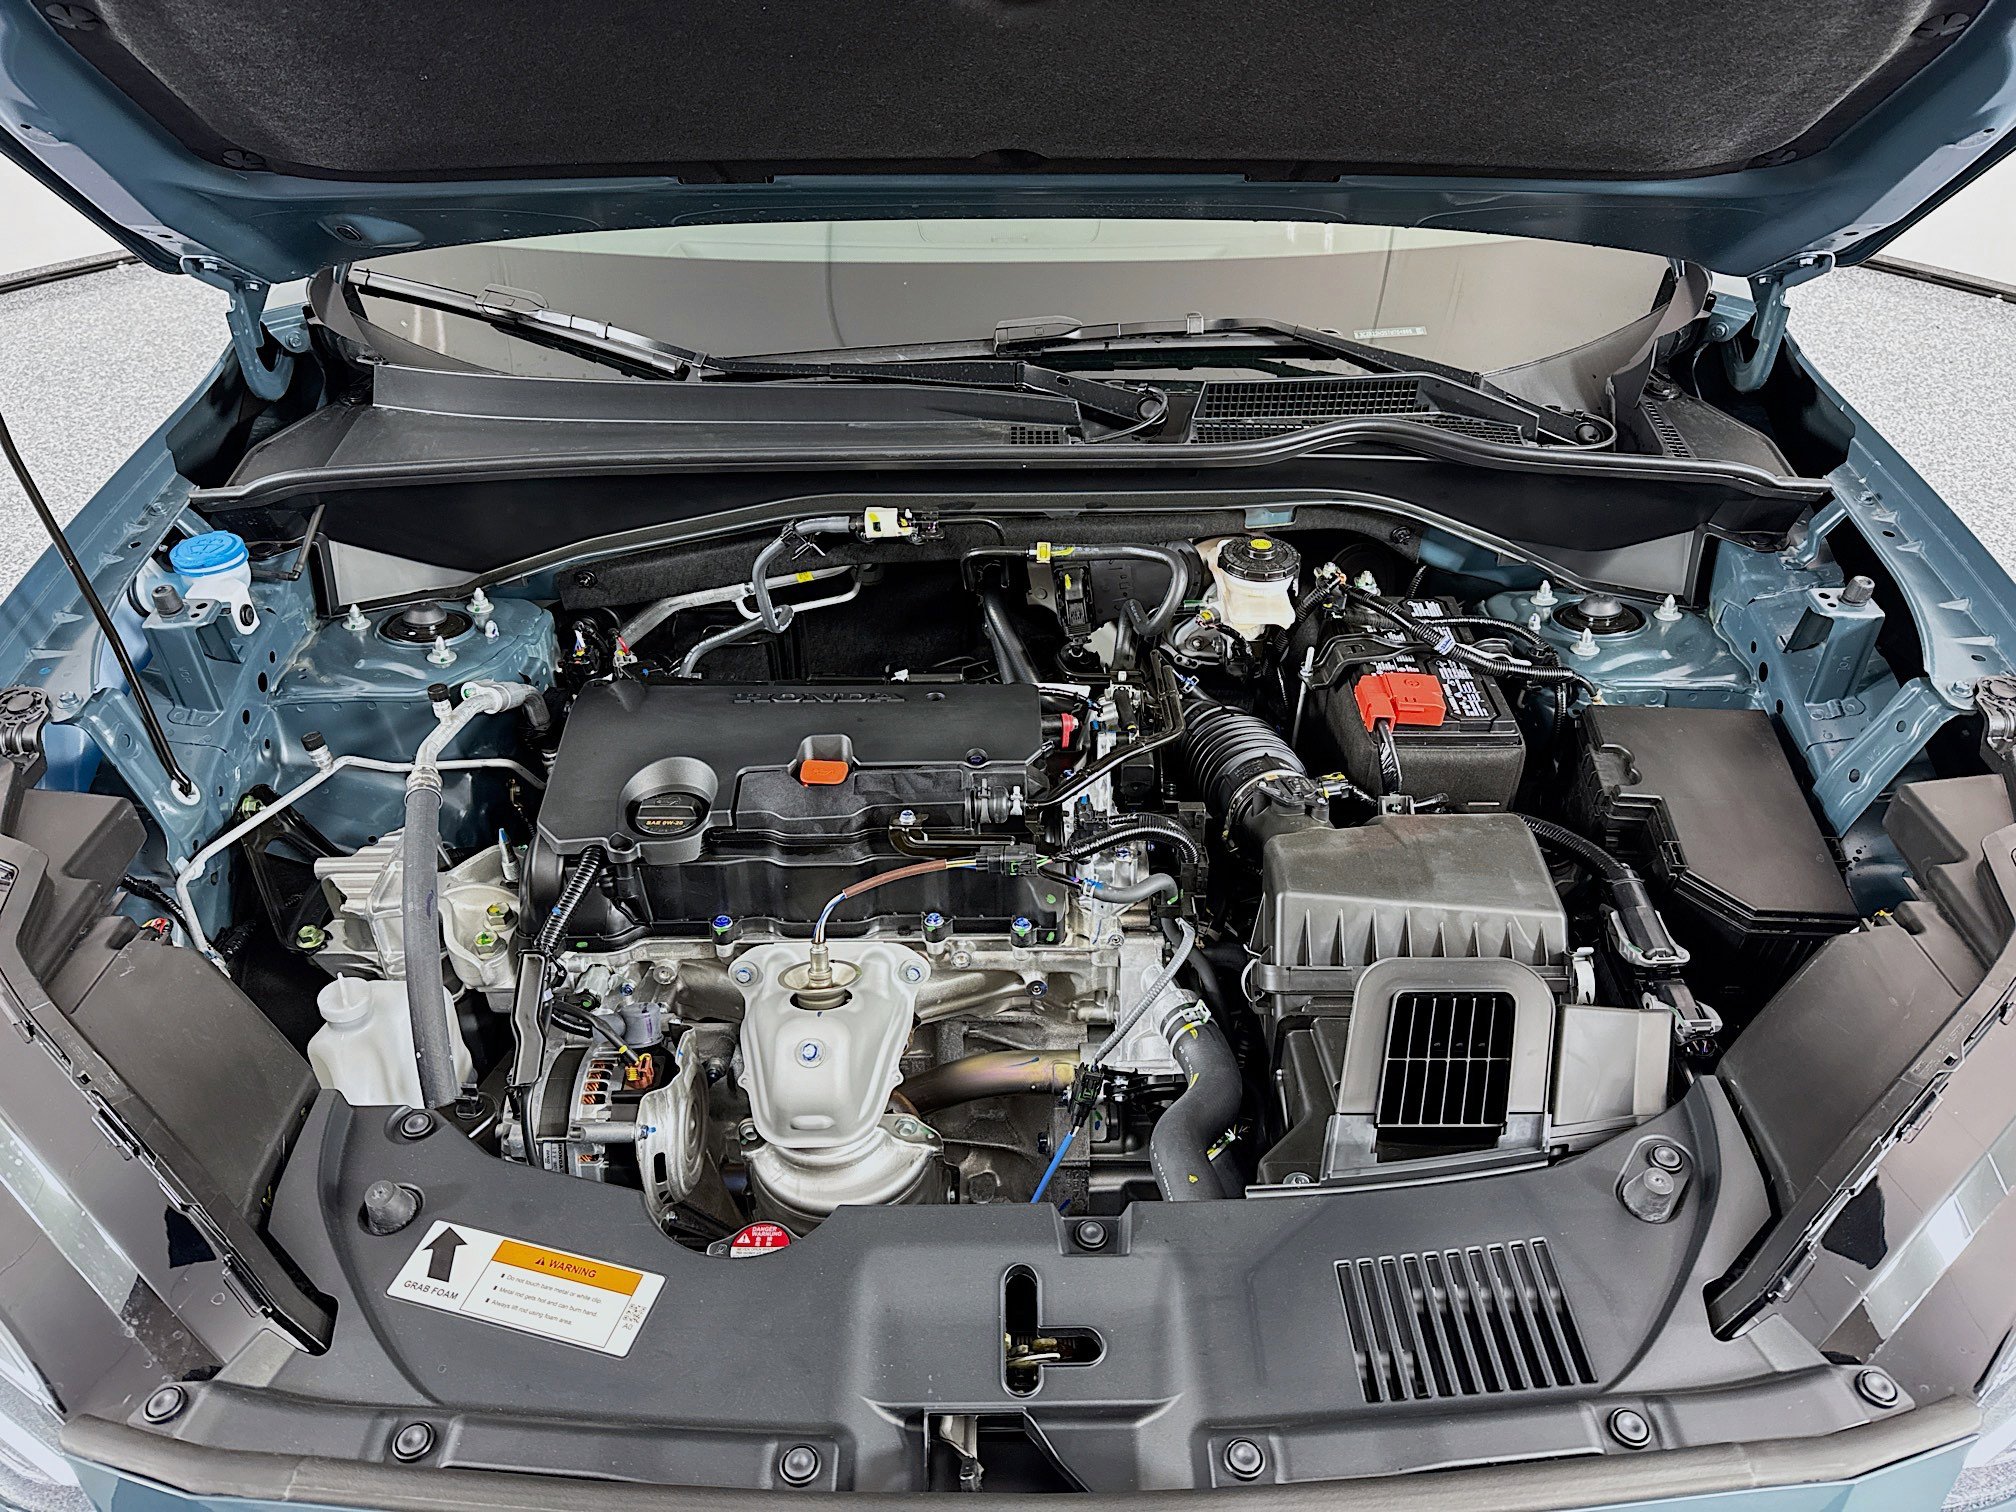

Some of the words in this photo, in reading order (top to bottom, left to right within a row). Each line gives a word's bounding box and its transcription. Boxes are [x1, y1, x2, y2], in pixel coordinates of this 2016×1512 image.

[733, 692, 906, 704] HONDA
[549, 1259, 597, 1278] WARNING
[404, 1280, 430, 1293] GRAB
[431, 1286, 459, 1300] FOAM
[499, 1287, 514, 1296] Metal
[537, 1296, 547, 1304] hot
[569, 1304, 582, 1312] burn
[525, 1279, 541, 1287] touch
[541, 1283, 554, 1291] bare
[553, 1287, 570, 1296] metal
[576, 1293, 591, 1301] white
[492, 1300, 511, 1310] Always
[528, 1310, 544, 1319] using
[544, 1312, 559, 1321] foam
